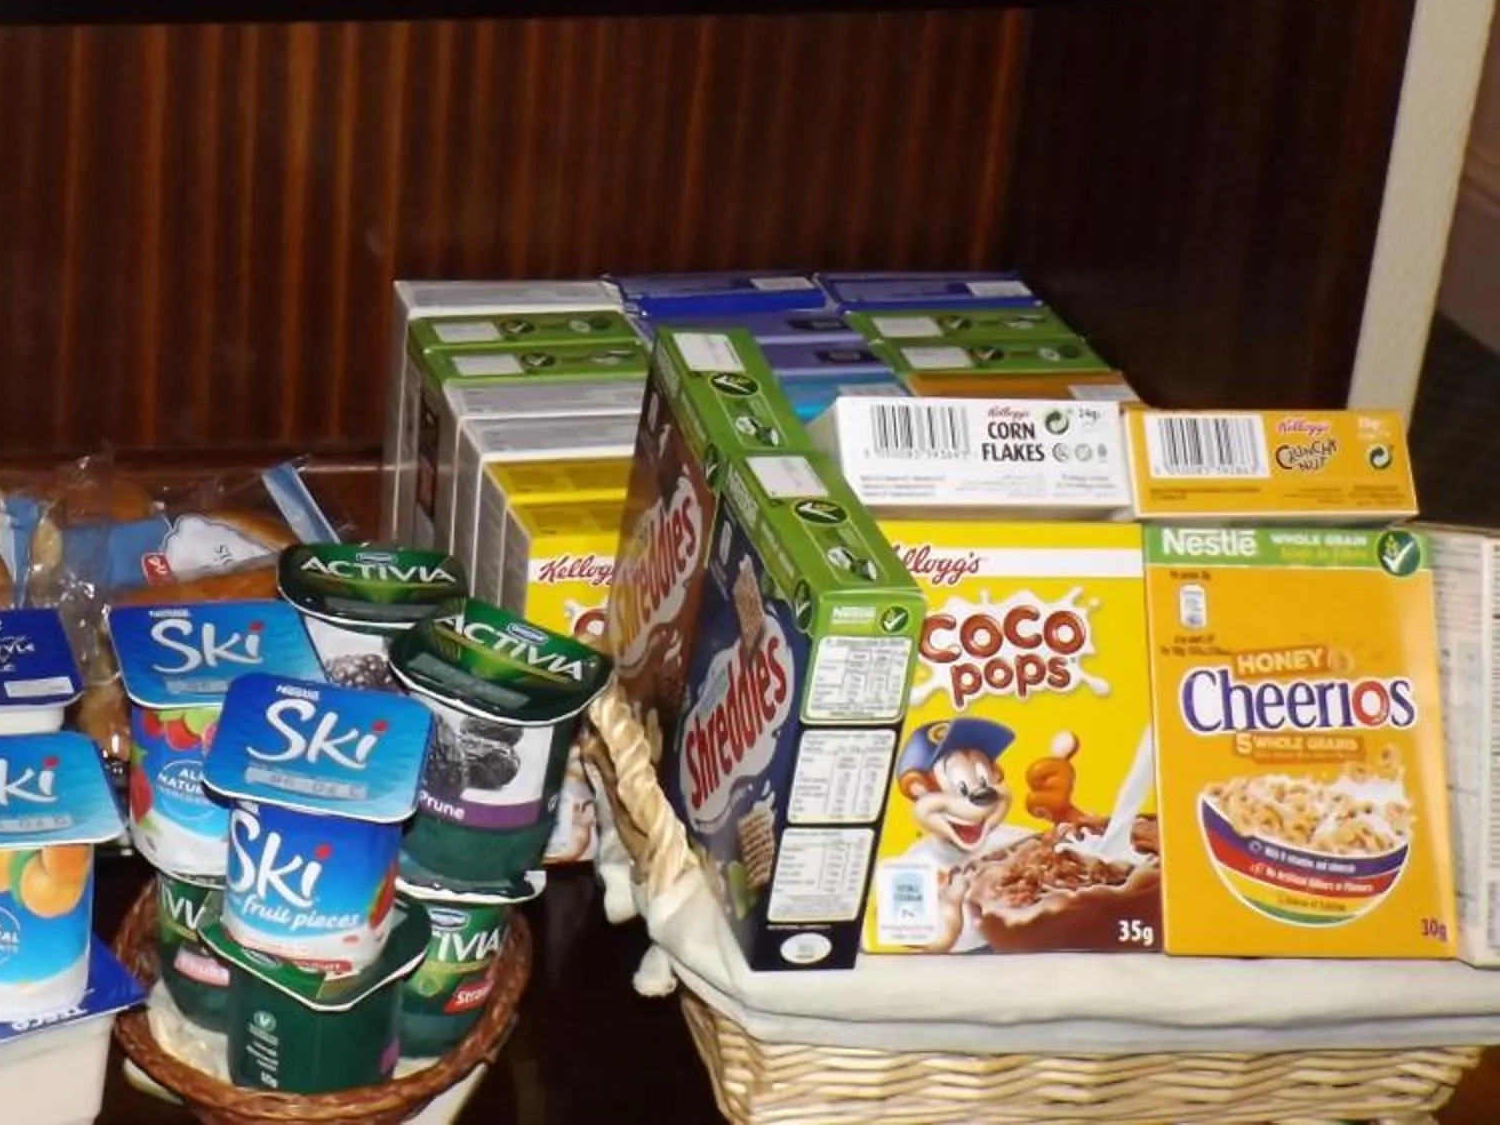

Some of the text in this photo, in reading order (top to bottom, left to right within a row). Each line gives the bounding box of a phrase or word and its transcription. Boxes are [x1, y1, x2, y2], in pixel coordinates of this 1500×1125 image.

[981, 442, 1046, 462] FLAKES
[987, 421, 1036, 440] CORN
[301, 556, 457, 583] ACTIVIA
[151, 618, 264, 674] Ski
[432, 614, 582, 681] ACTIVIA
[1237, 648, 1324, 675] HONEY
[950, 653, 1071, 708] pops
[1181, 669, 1416, 733] Cheerios
[246, 698, 390, 770] Ski
[685, 636, 788, 810] Shreddies
[1235, 734, 1253, 754] 5
[228, 808, 333, 908] Ski
[242, 894, 361, 932] fruit pieces
[1117, 920, 1154, 946] 35g
